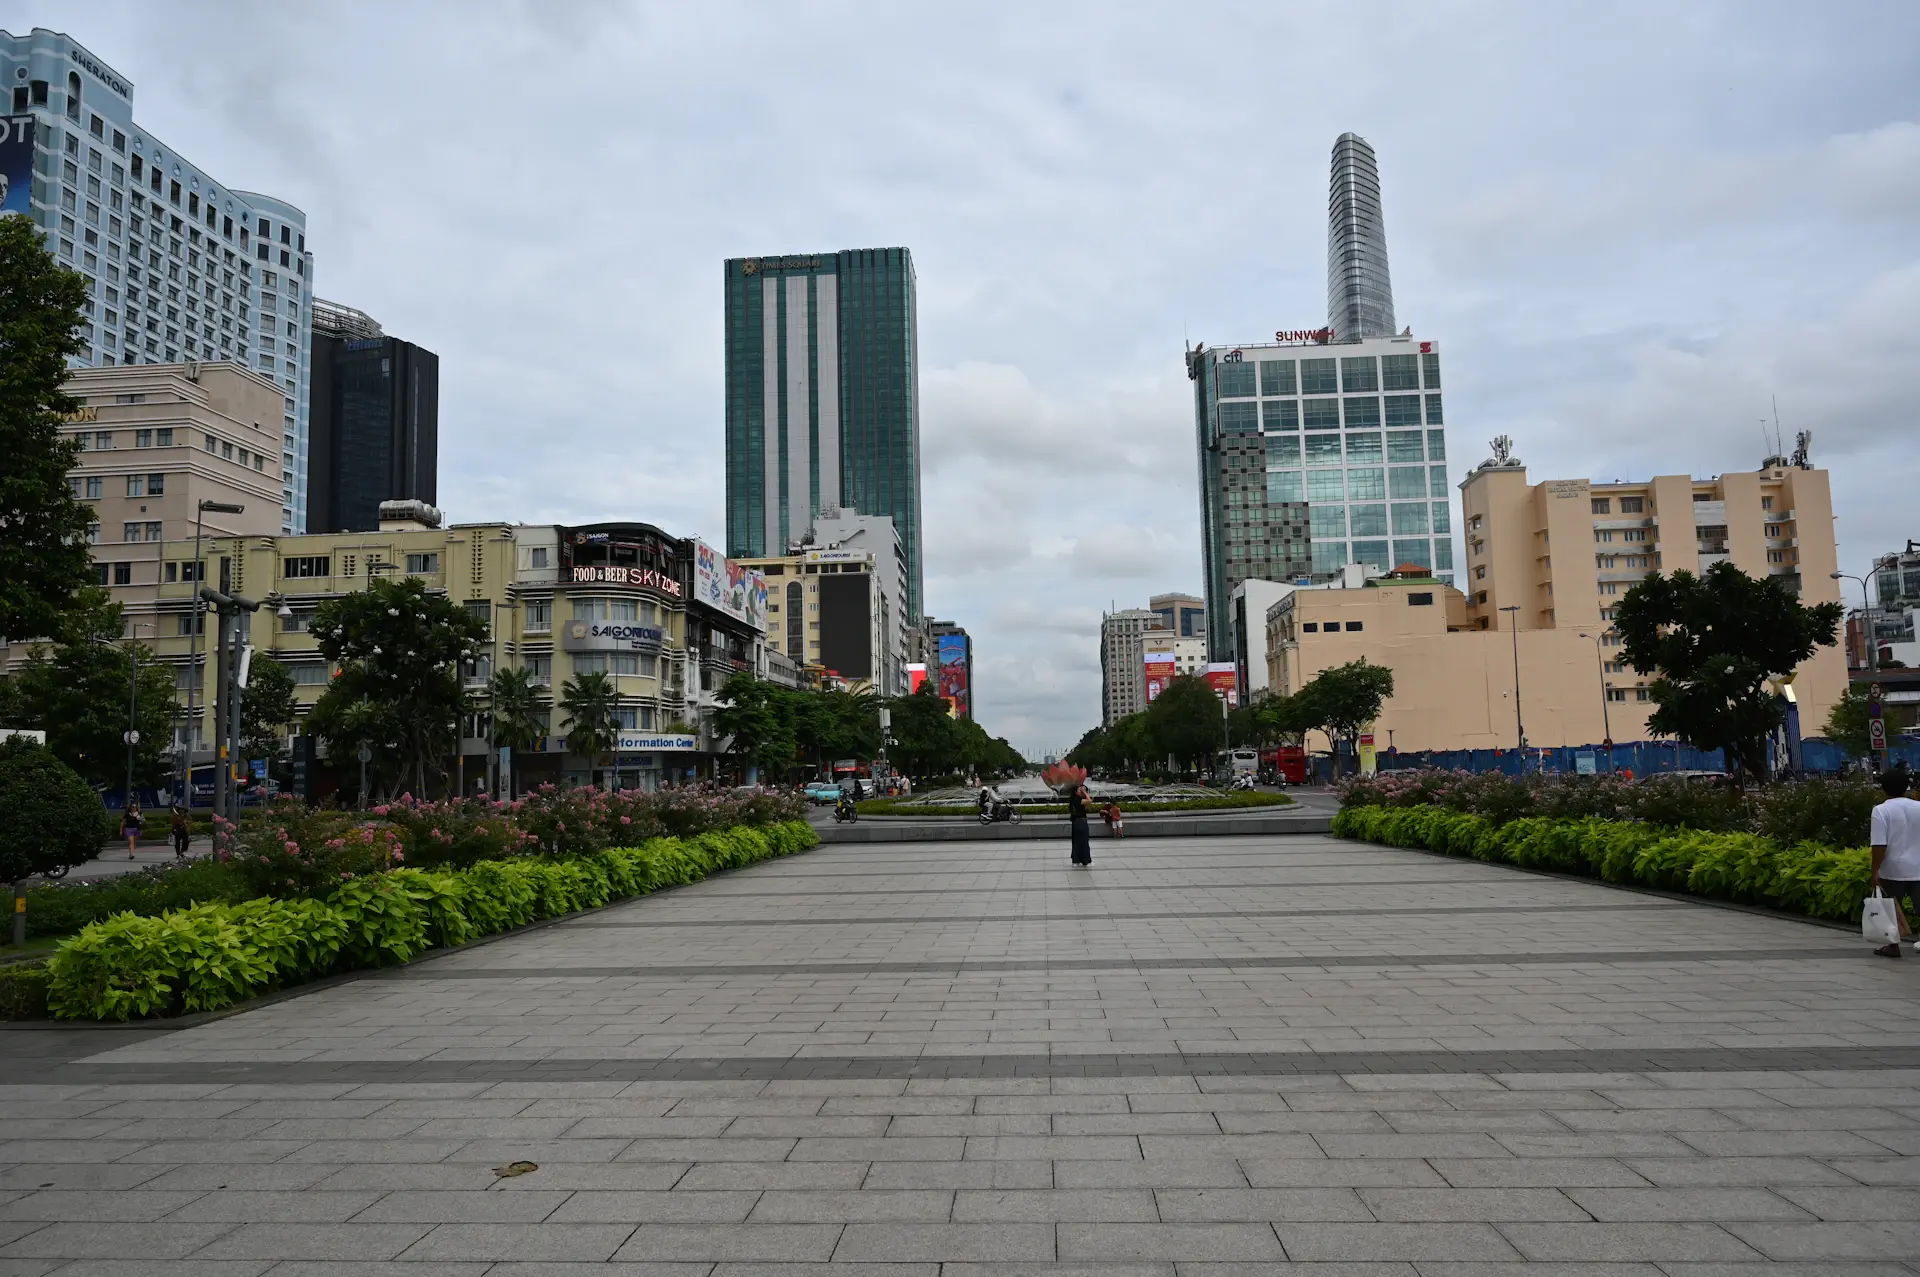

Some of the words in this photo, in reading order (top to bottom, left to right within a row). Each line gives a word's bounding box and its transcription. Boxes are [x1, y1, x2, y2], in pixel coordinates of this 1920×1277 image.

[72, 50, 128, 98] SHERATON
[761, 261, 785, 270] TIMES
[787, 260, 821, 269] SQUARE
[1276, 328, 1335, 342] SUNWAH
[1223, 350, 1243, 363] citi
[573, 567, 596, 582] FOOD
[597, 569, 604, 581] &
[605, 567, 628, 583] BEER
[630, 568, 662, 588] SKY
[662, 575, 681, 597] ZONE
[617, 737, 674, 748] formation
